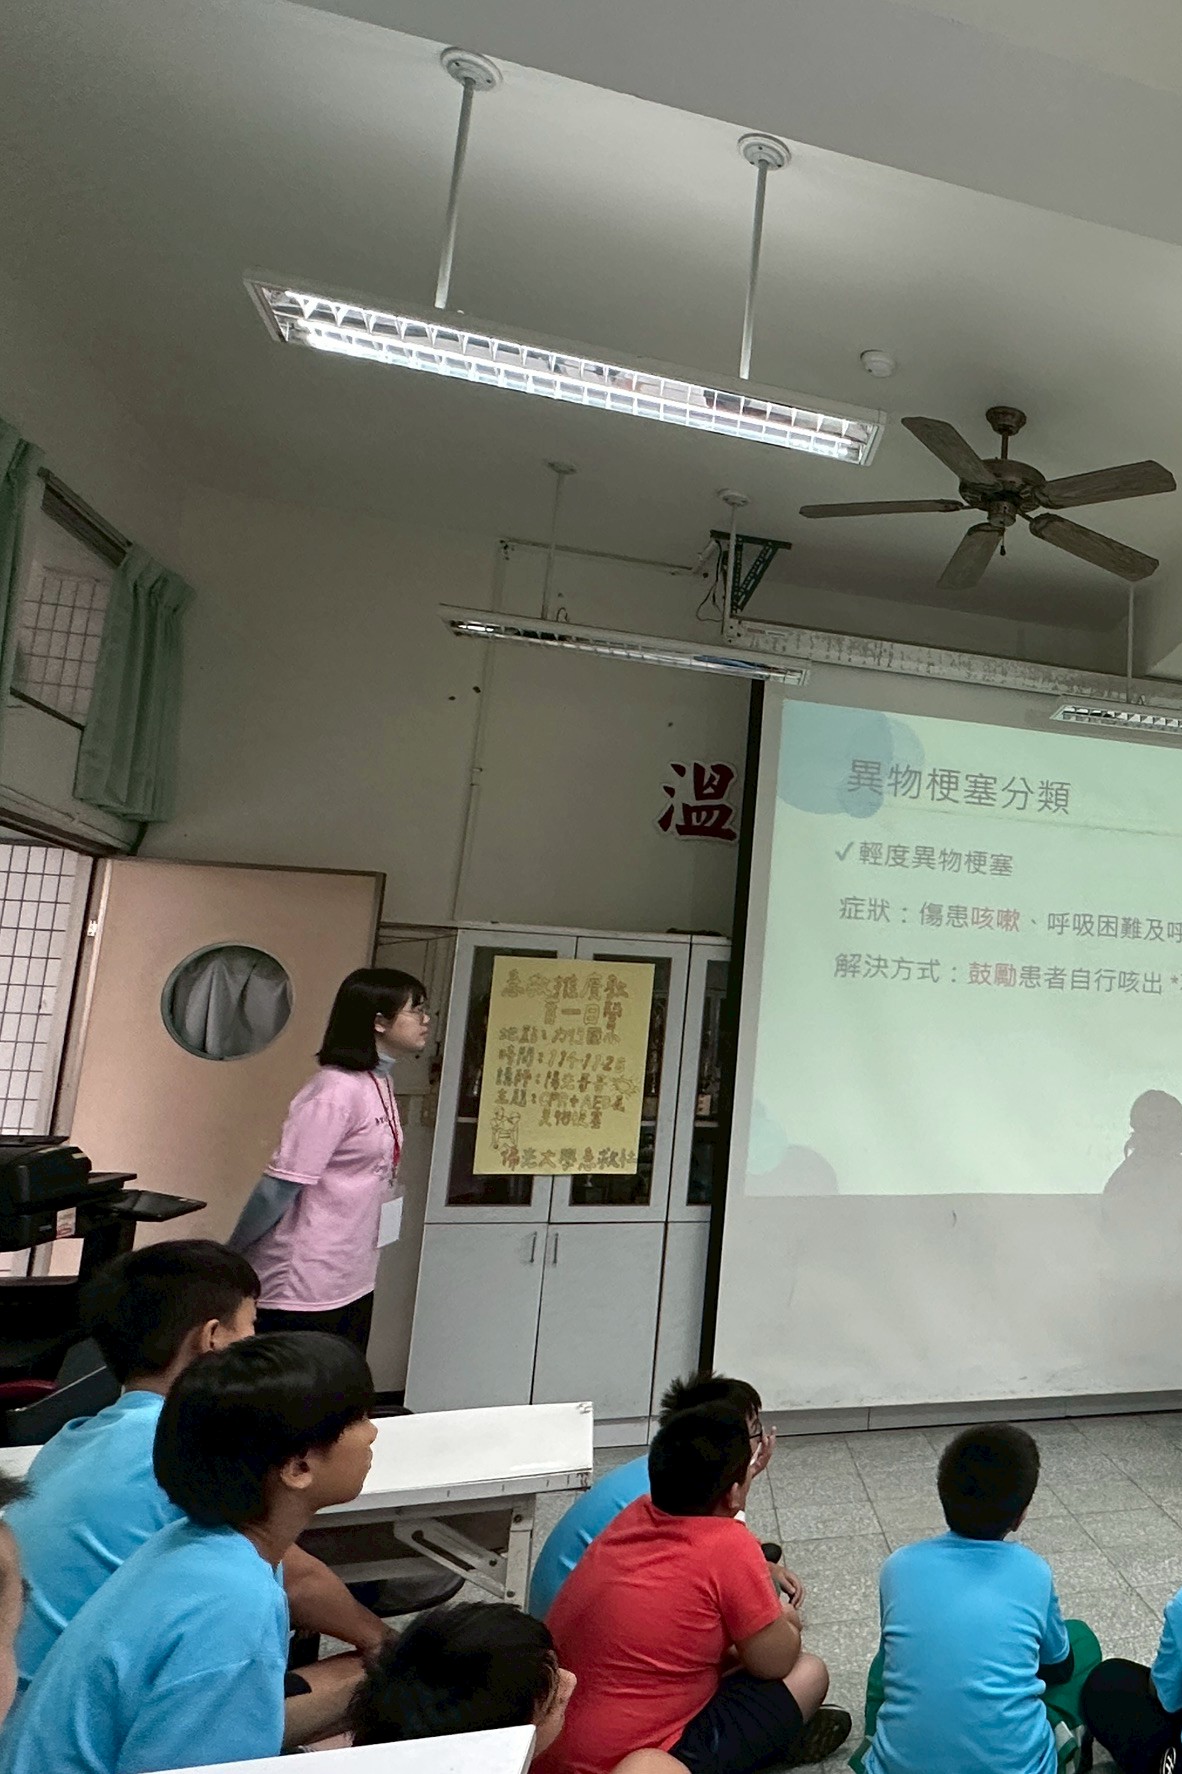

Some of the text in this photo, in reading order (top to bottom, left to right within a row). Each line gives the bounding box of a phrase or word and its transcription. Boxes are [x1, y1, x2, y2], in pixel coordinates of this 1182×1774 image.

[658, 762, 737, 841] 溫
[847, 759, 1071, 815] 異物梗塞分類
[859, 842, 1014, 877] 輕度異物梗塞
